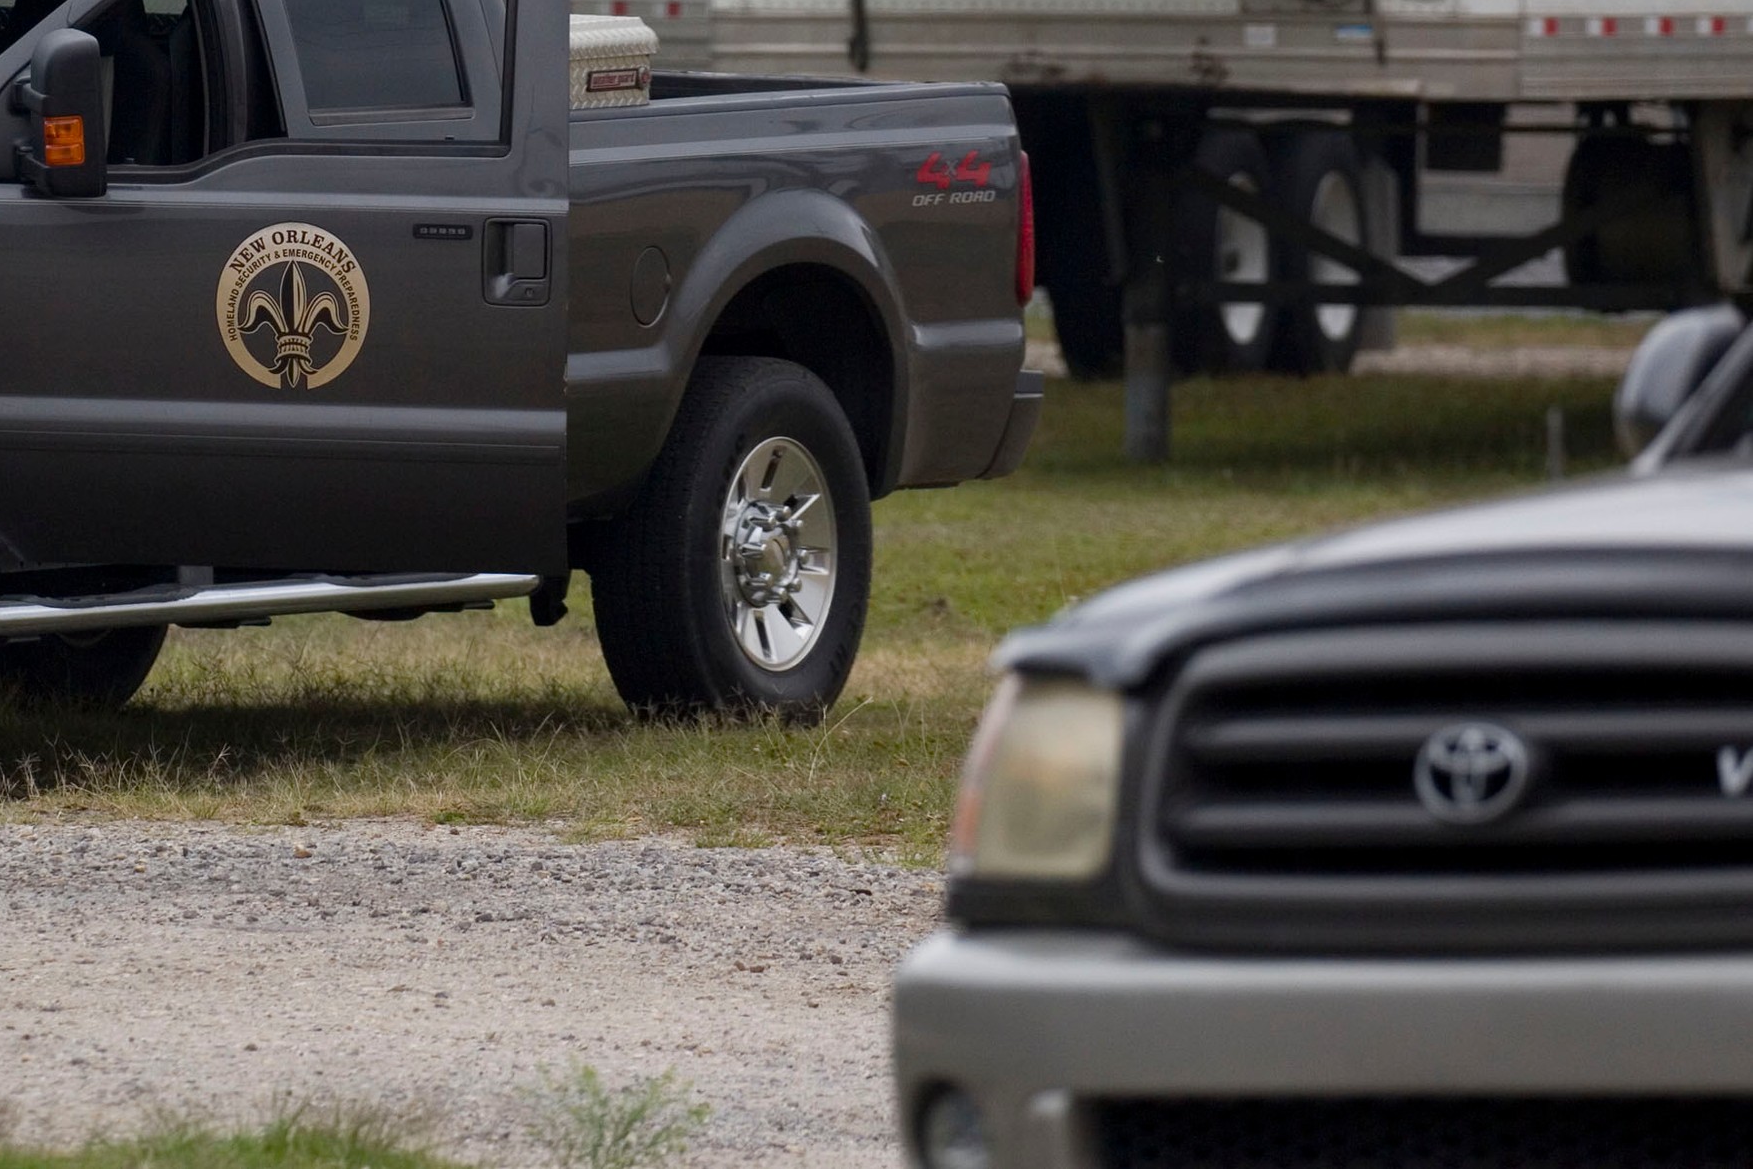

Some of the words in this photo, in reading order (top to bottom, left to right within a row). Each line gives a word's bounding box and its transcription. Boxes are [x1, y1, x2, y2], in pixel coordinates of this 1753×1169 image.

[912, 193, 945, 206] OFF
[949, 190, 996, 203] ROAD
[229, 237, 266, 274] NEW
[272, 230, 356, 274] ORLEANS
[226, 288, 240, 342] HOMELAND
[236, 253, 271, 288] SECURITY
[274, 250, 281, 259] &
[283, 248, 336, 271] EMERGENCY
[336, 270, 361, 341] PREPAREDNESS
